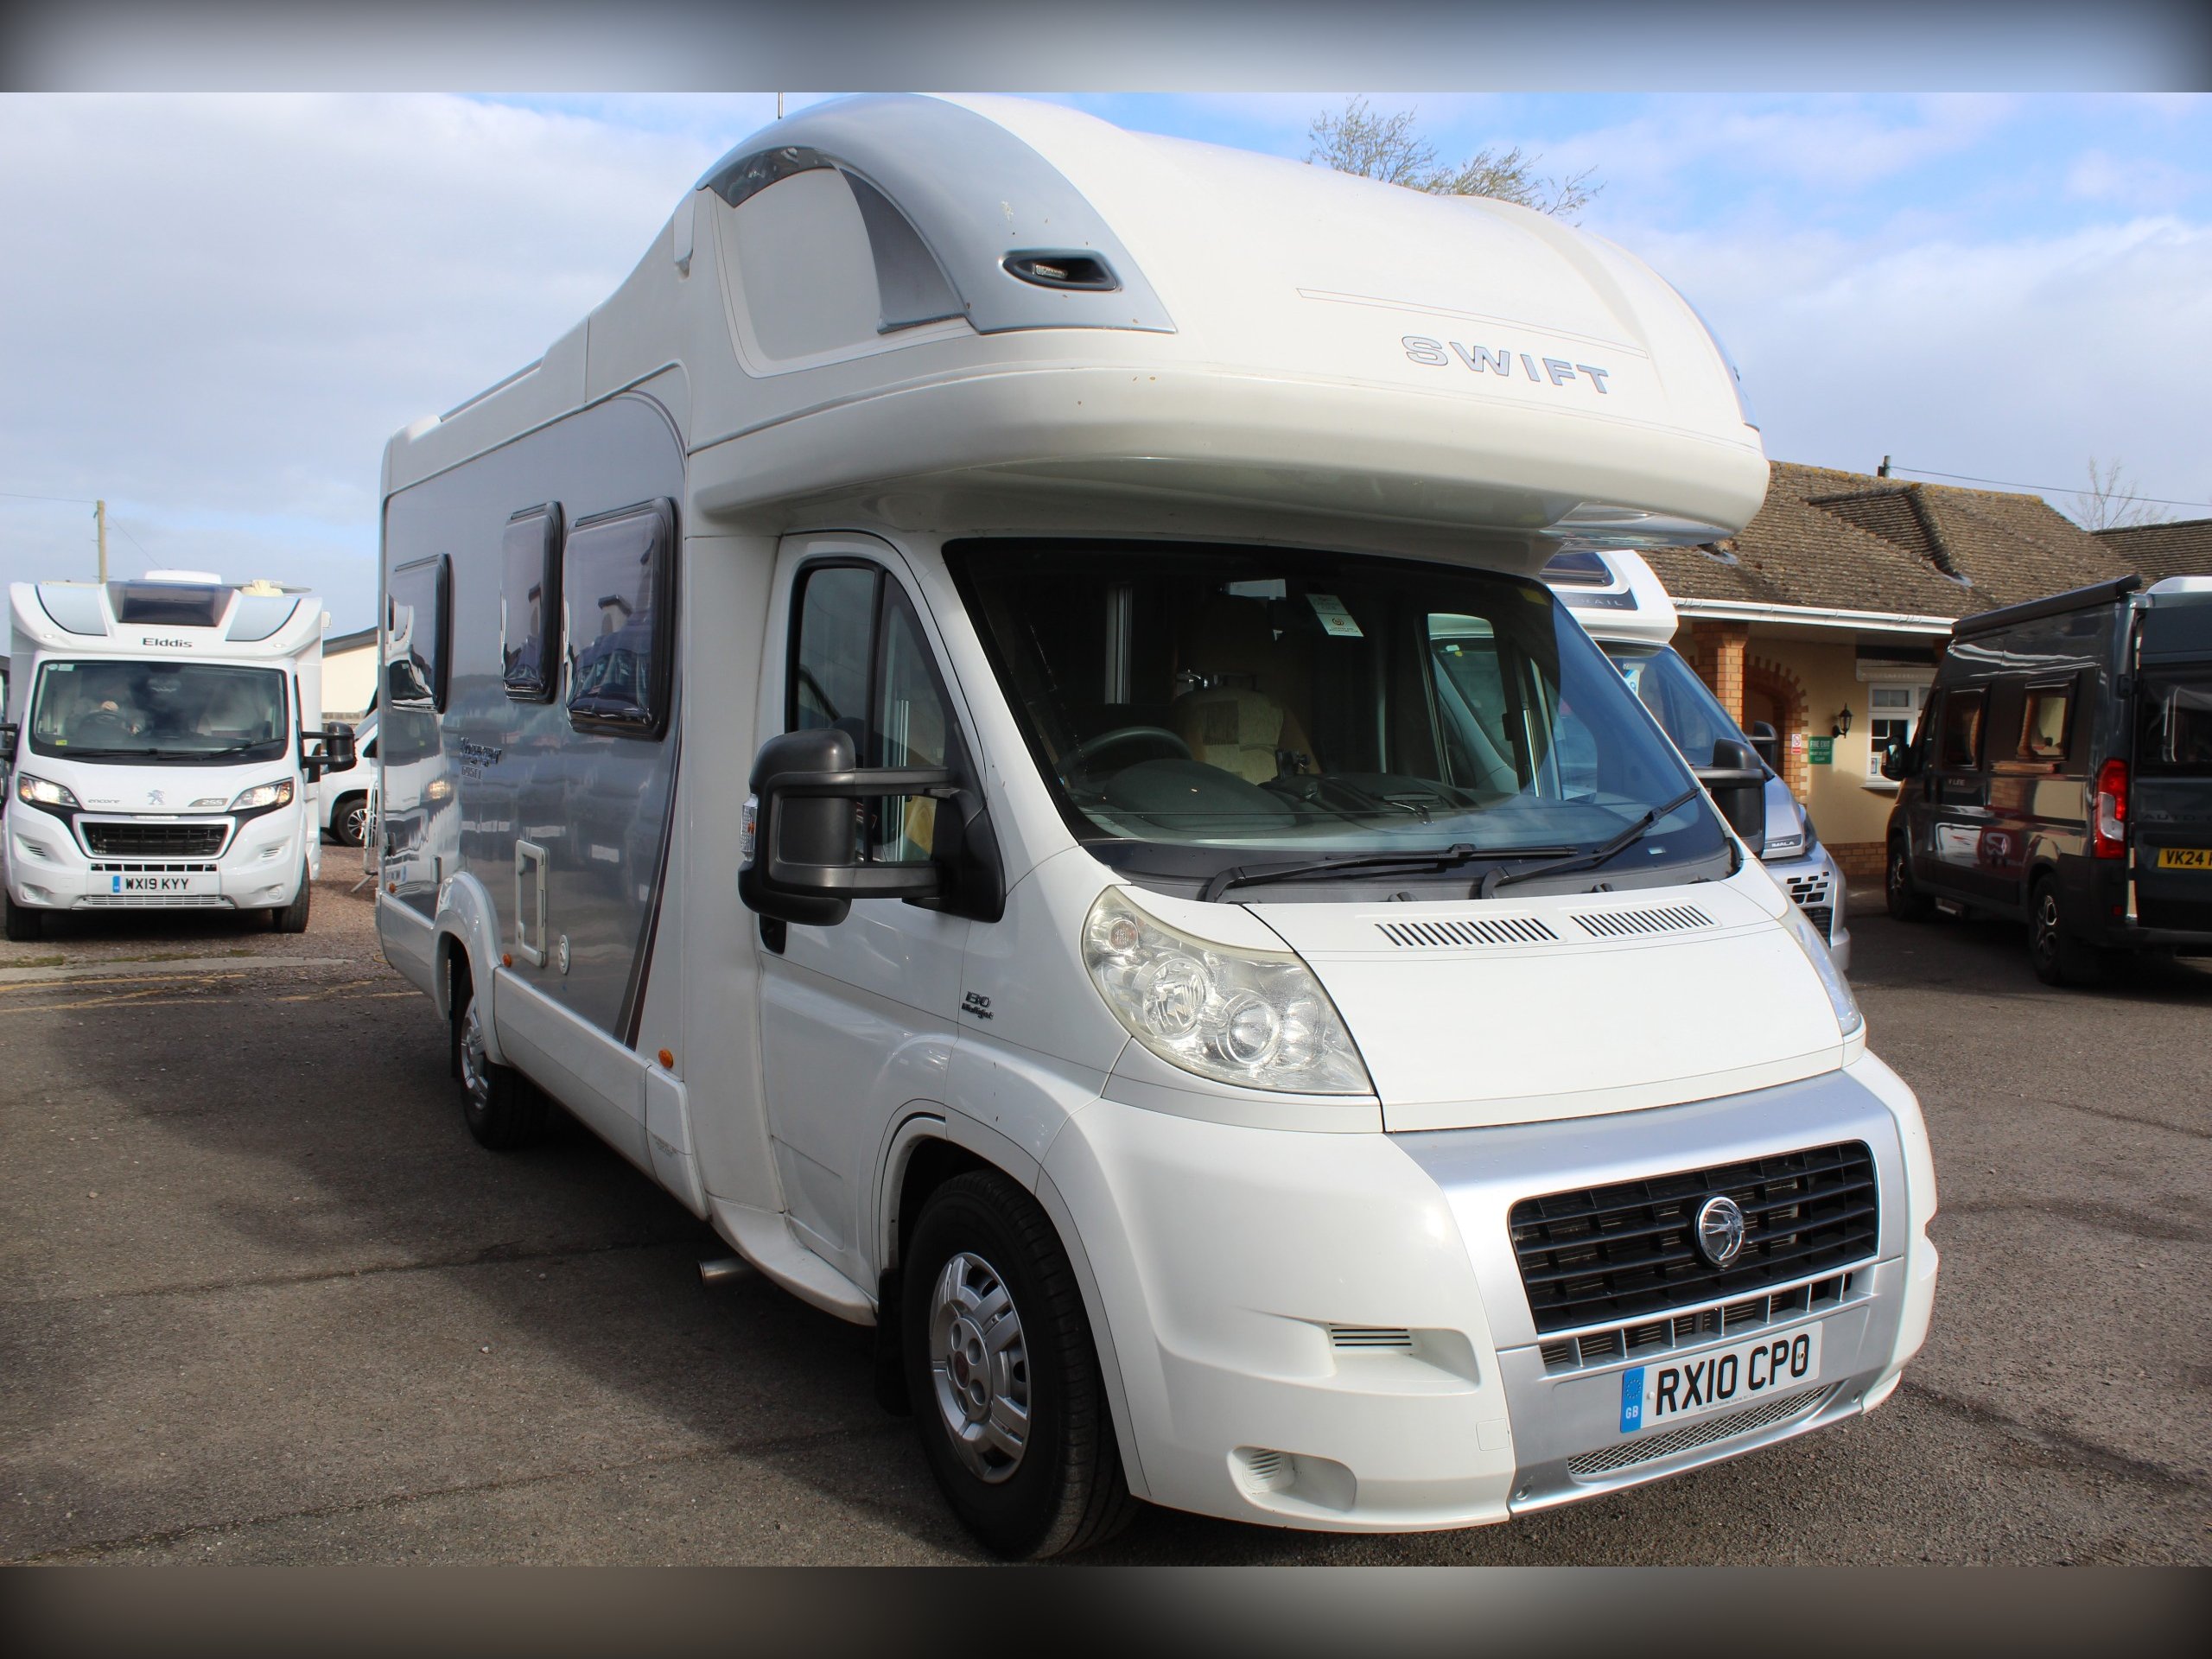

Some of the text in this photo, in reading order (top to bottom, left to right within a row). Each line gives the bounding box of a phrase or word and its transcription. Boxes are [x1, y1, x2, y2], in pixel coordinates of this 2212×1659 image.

[1401, 335, 1609, 394] SWIFT
[142, 638, 193, 648] Elddis
[2167, 850, 2204, 866] VK24
[125, 878, 157, 890] WX19
[162, 878, 189, 890] KYY
[1656, 1333, 1810, 1416] RX10 CPO
[1625, 1405, 1639, 1420] GB
